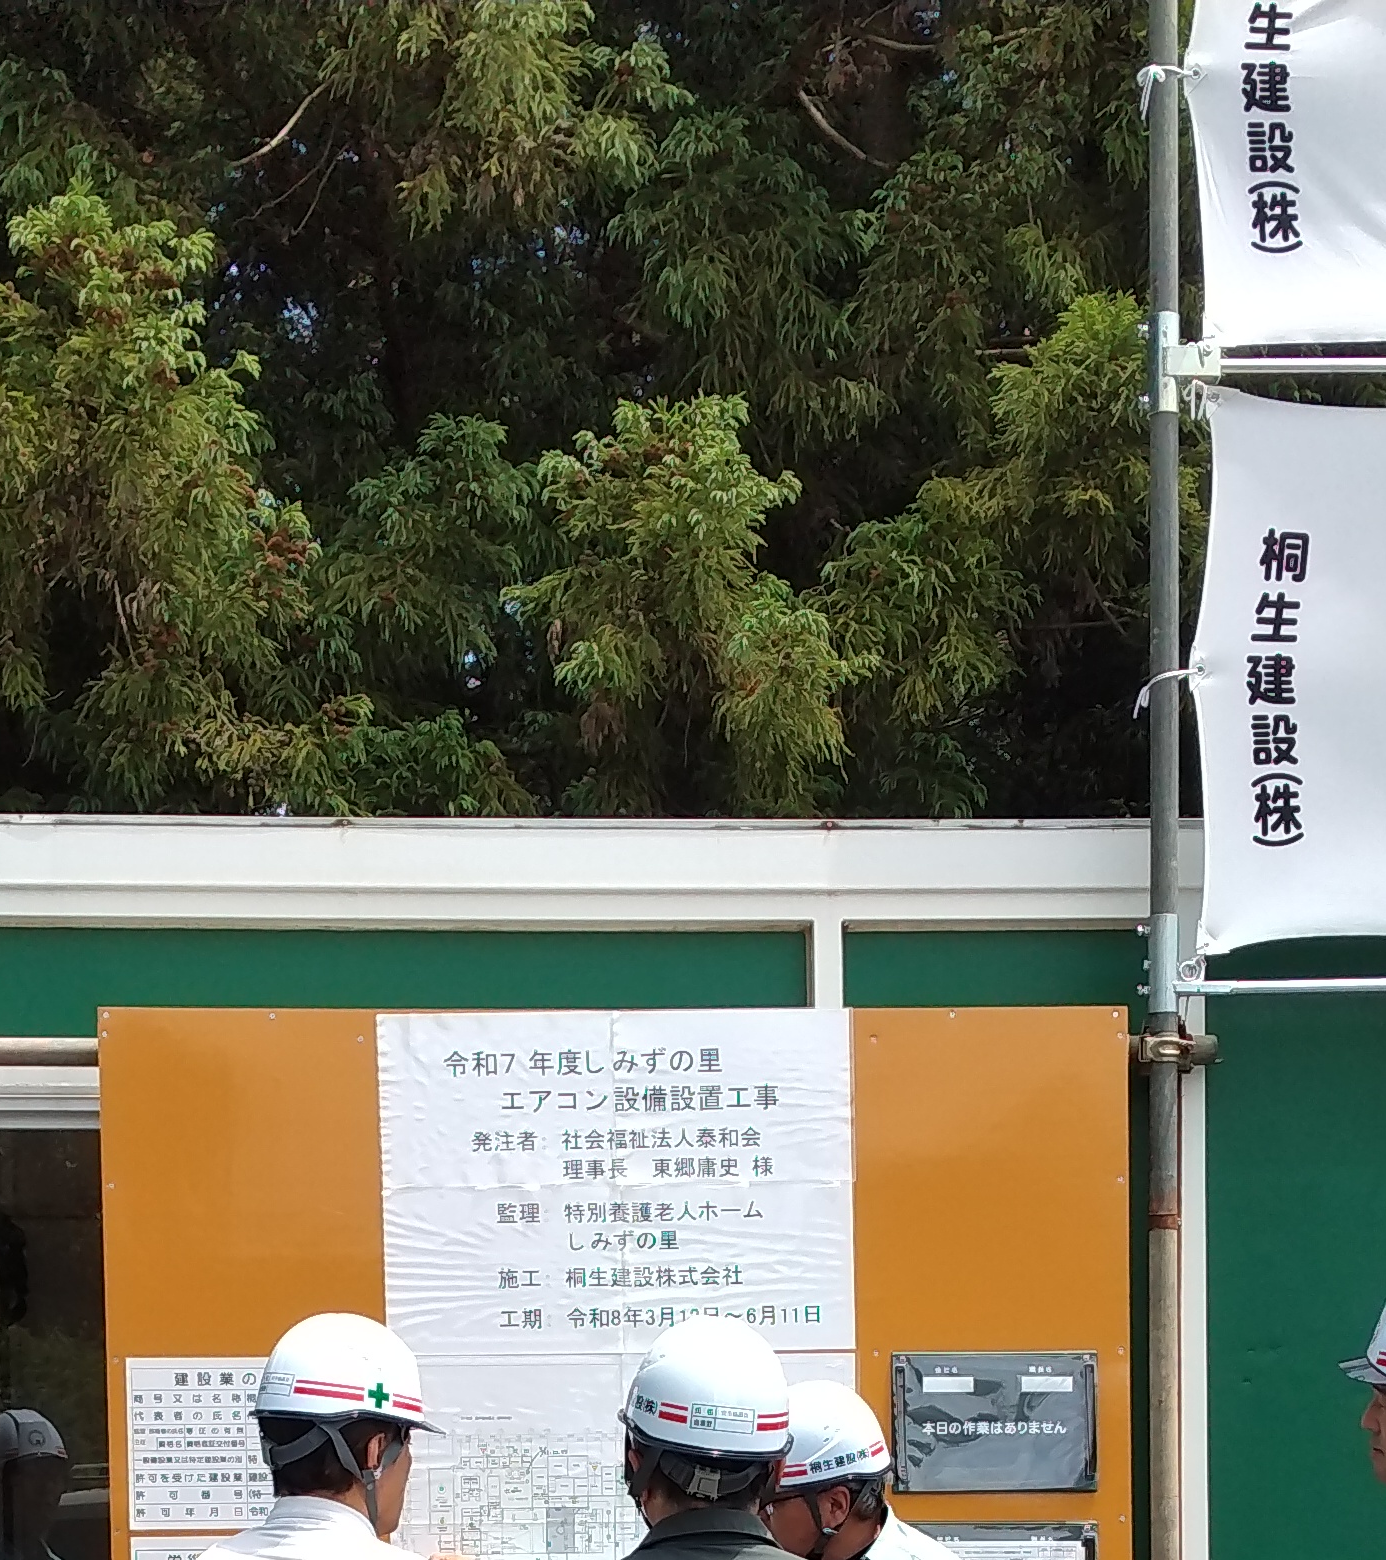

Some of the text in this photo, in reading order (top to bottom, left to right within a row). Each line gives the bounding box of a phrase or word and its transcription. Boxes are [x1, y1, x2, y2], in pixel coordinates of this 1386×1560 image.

[1245, 527, 1310, 848] 桐生建設(株)
[501, 1084, 779, 1113] エアコン設備設置工事
[562, 1158, 628, 1180] 理事長
[752, 1156, 774, 1177] 様
[569, 1229, 680, 1251] しみずの里
[921, 1421, 1067, 1435] 本日の作業はありません
